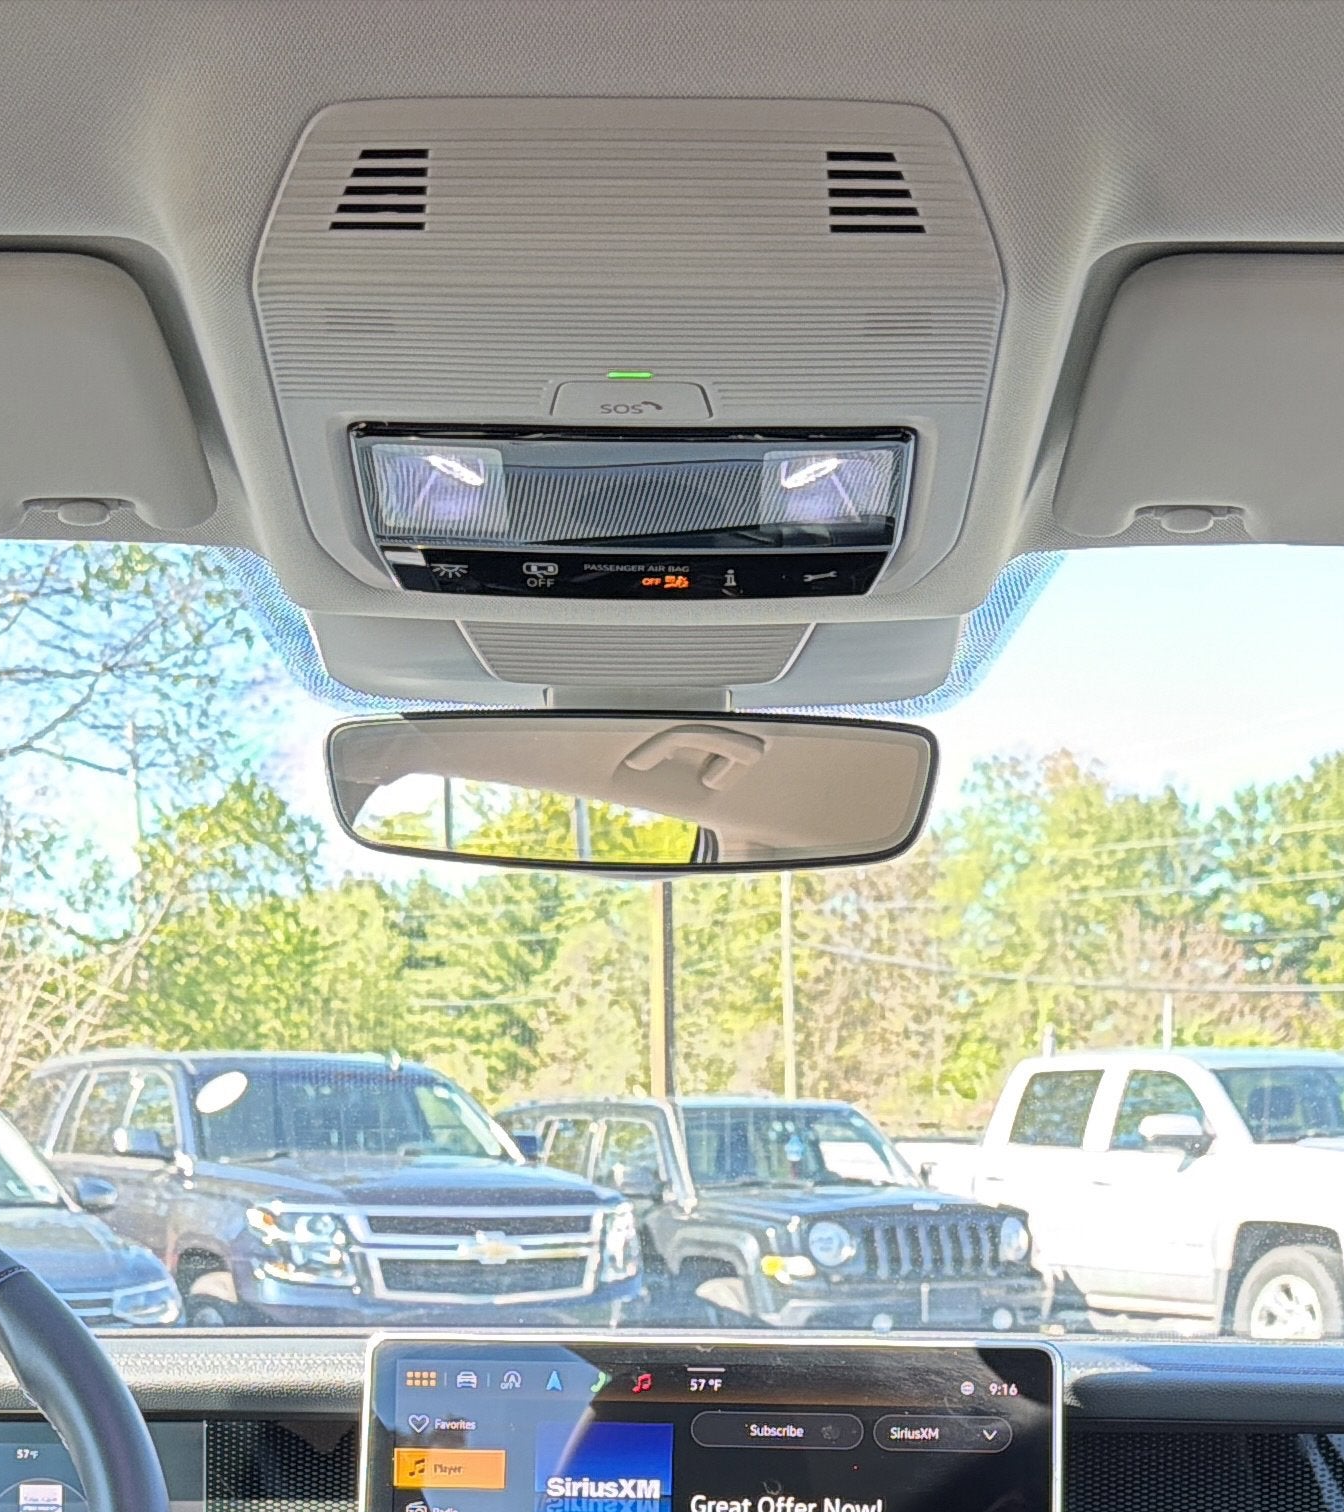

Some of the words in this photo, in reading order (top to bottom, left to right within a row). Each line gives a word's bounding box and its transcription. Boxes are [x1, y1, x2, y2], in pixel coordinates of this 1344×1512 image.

[600, 403, 644, 414] SOS
[583, 563, 646, 572] PASSENGER
[647, 564, 666, 573] AIR
[667, 565, 690, 573] BAG
[526, 577, 556, 588] OFF
[641, 577, 662, 587] OFF
[689, 1378, 707, 1392] 57
[989, 1382, 1019, 1396] 9:16
[434, 1418, 476, 1431] Favorites
[749, 1424, 805, 1438] Subscribe
[889, 1427, 940, 1441] SiriusXM
[433, 1463, 464, 1476] Player
[546, 1476, 661, 1499] SiriusXM
